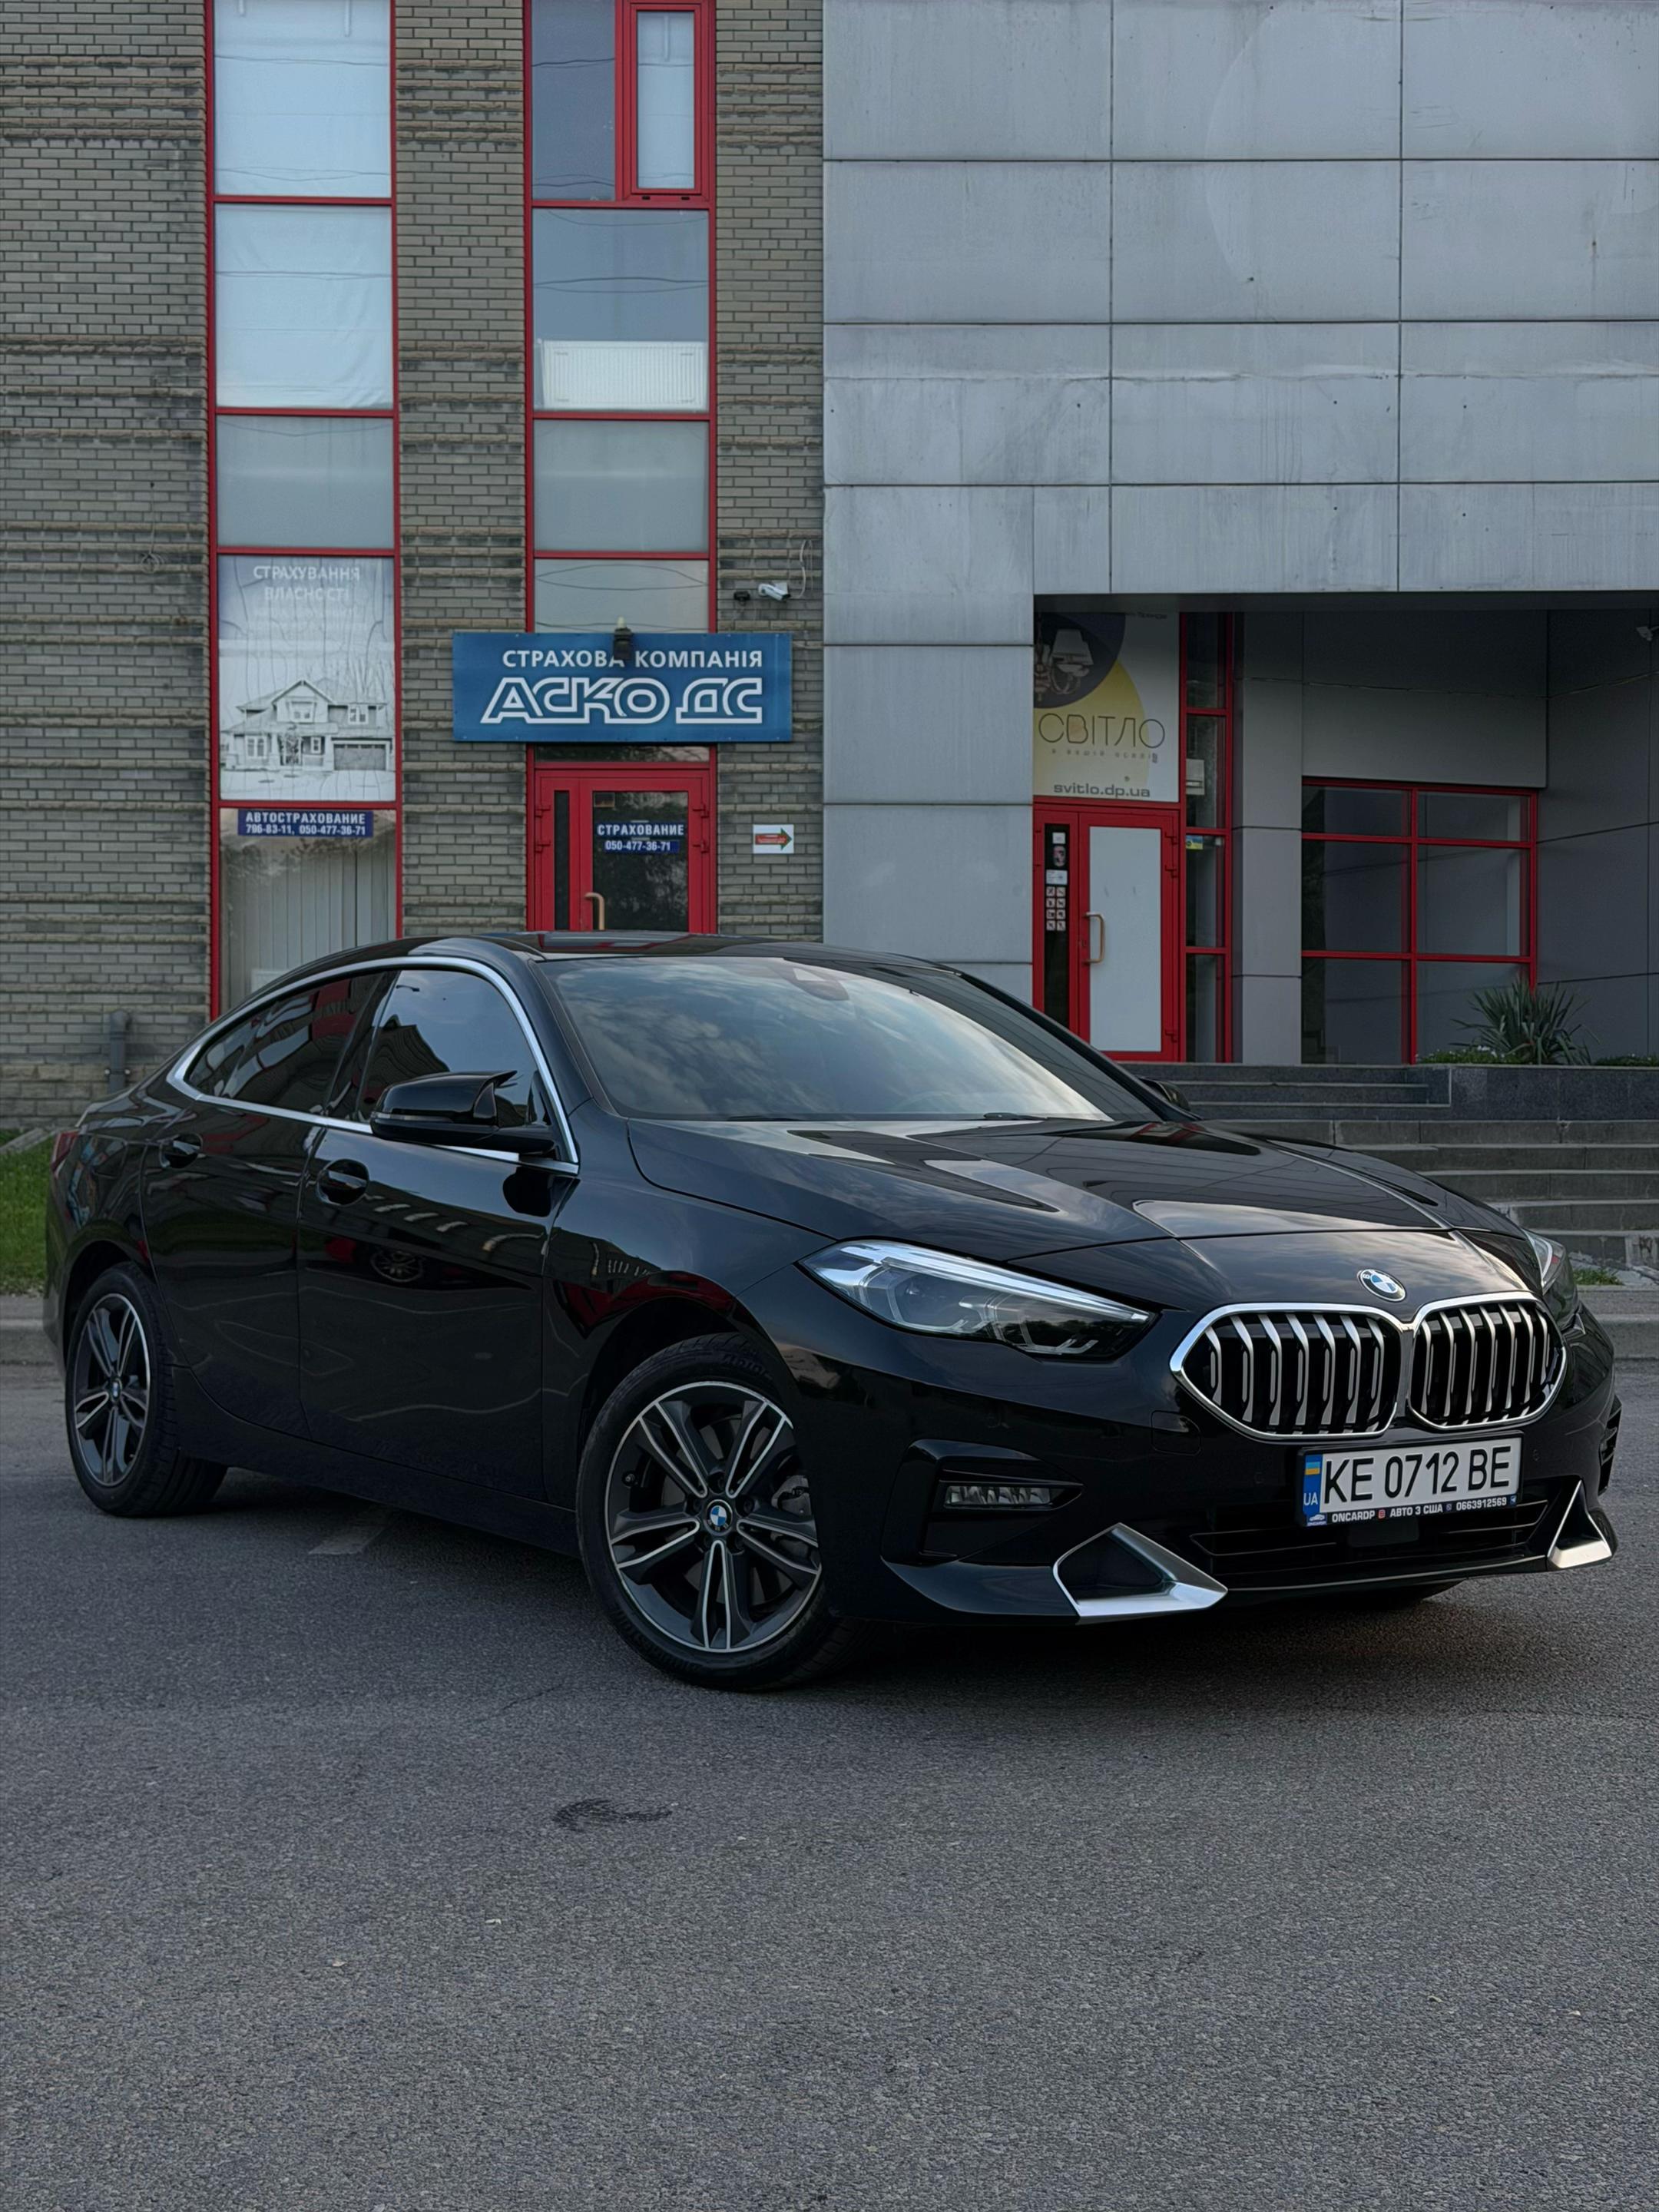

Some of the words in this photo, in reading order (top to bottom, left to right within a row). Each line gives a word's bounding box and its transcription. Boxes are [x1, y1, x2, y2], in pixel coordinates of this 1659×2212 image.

[253, 565, 360, 581] СТРАХУВАННЯ
[635, 650, 763, 668] КОМПАНІЯ
[480, 677, 670, 724] АСКО
[675, 677, 763, 724] ДС
[1038, 713, 1165, 749] СВІТЛО
[1054, 783, 1151, 798] svitlo.dp.ua
[246, 812, 366, 824] АВТОСТРАХОВАНИЕ
[300, 825, 366, 836] 050-477-36-71
[597, 824, 684, 836] СТРАХОВАНИЕ
[604, 840, 671, 851] 050-477-36-71
[1324, 1457, 1374, 1504] KE
[1384, 1452, 1459, 1498] 0712
[1468, 1445, 1512, 1491] BE
[1303, 1492, 1319, 1506] UA
[1332, 1510, 1376, 1523] ONCARDP
[1389, 1506, 1413, 1518] АВТО
[1423, 1504, 1443, 1515] США
[1456, 1497, 1507, 1511] 0663912569
